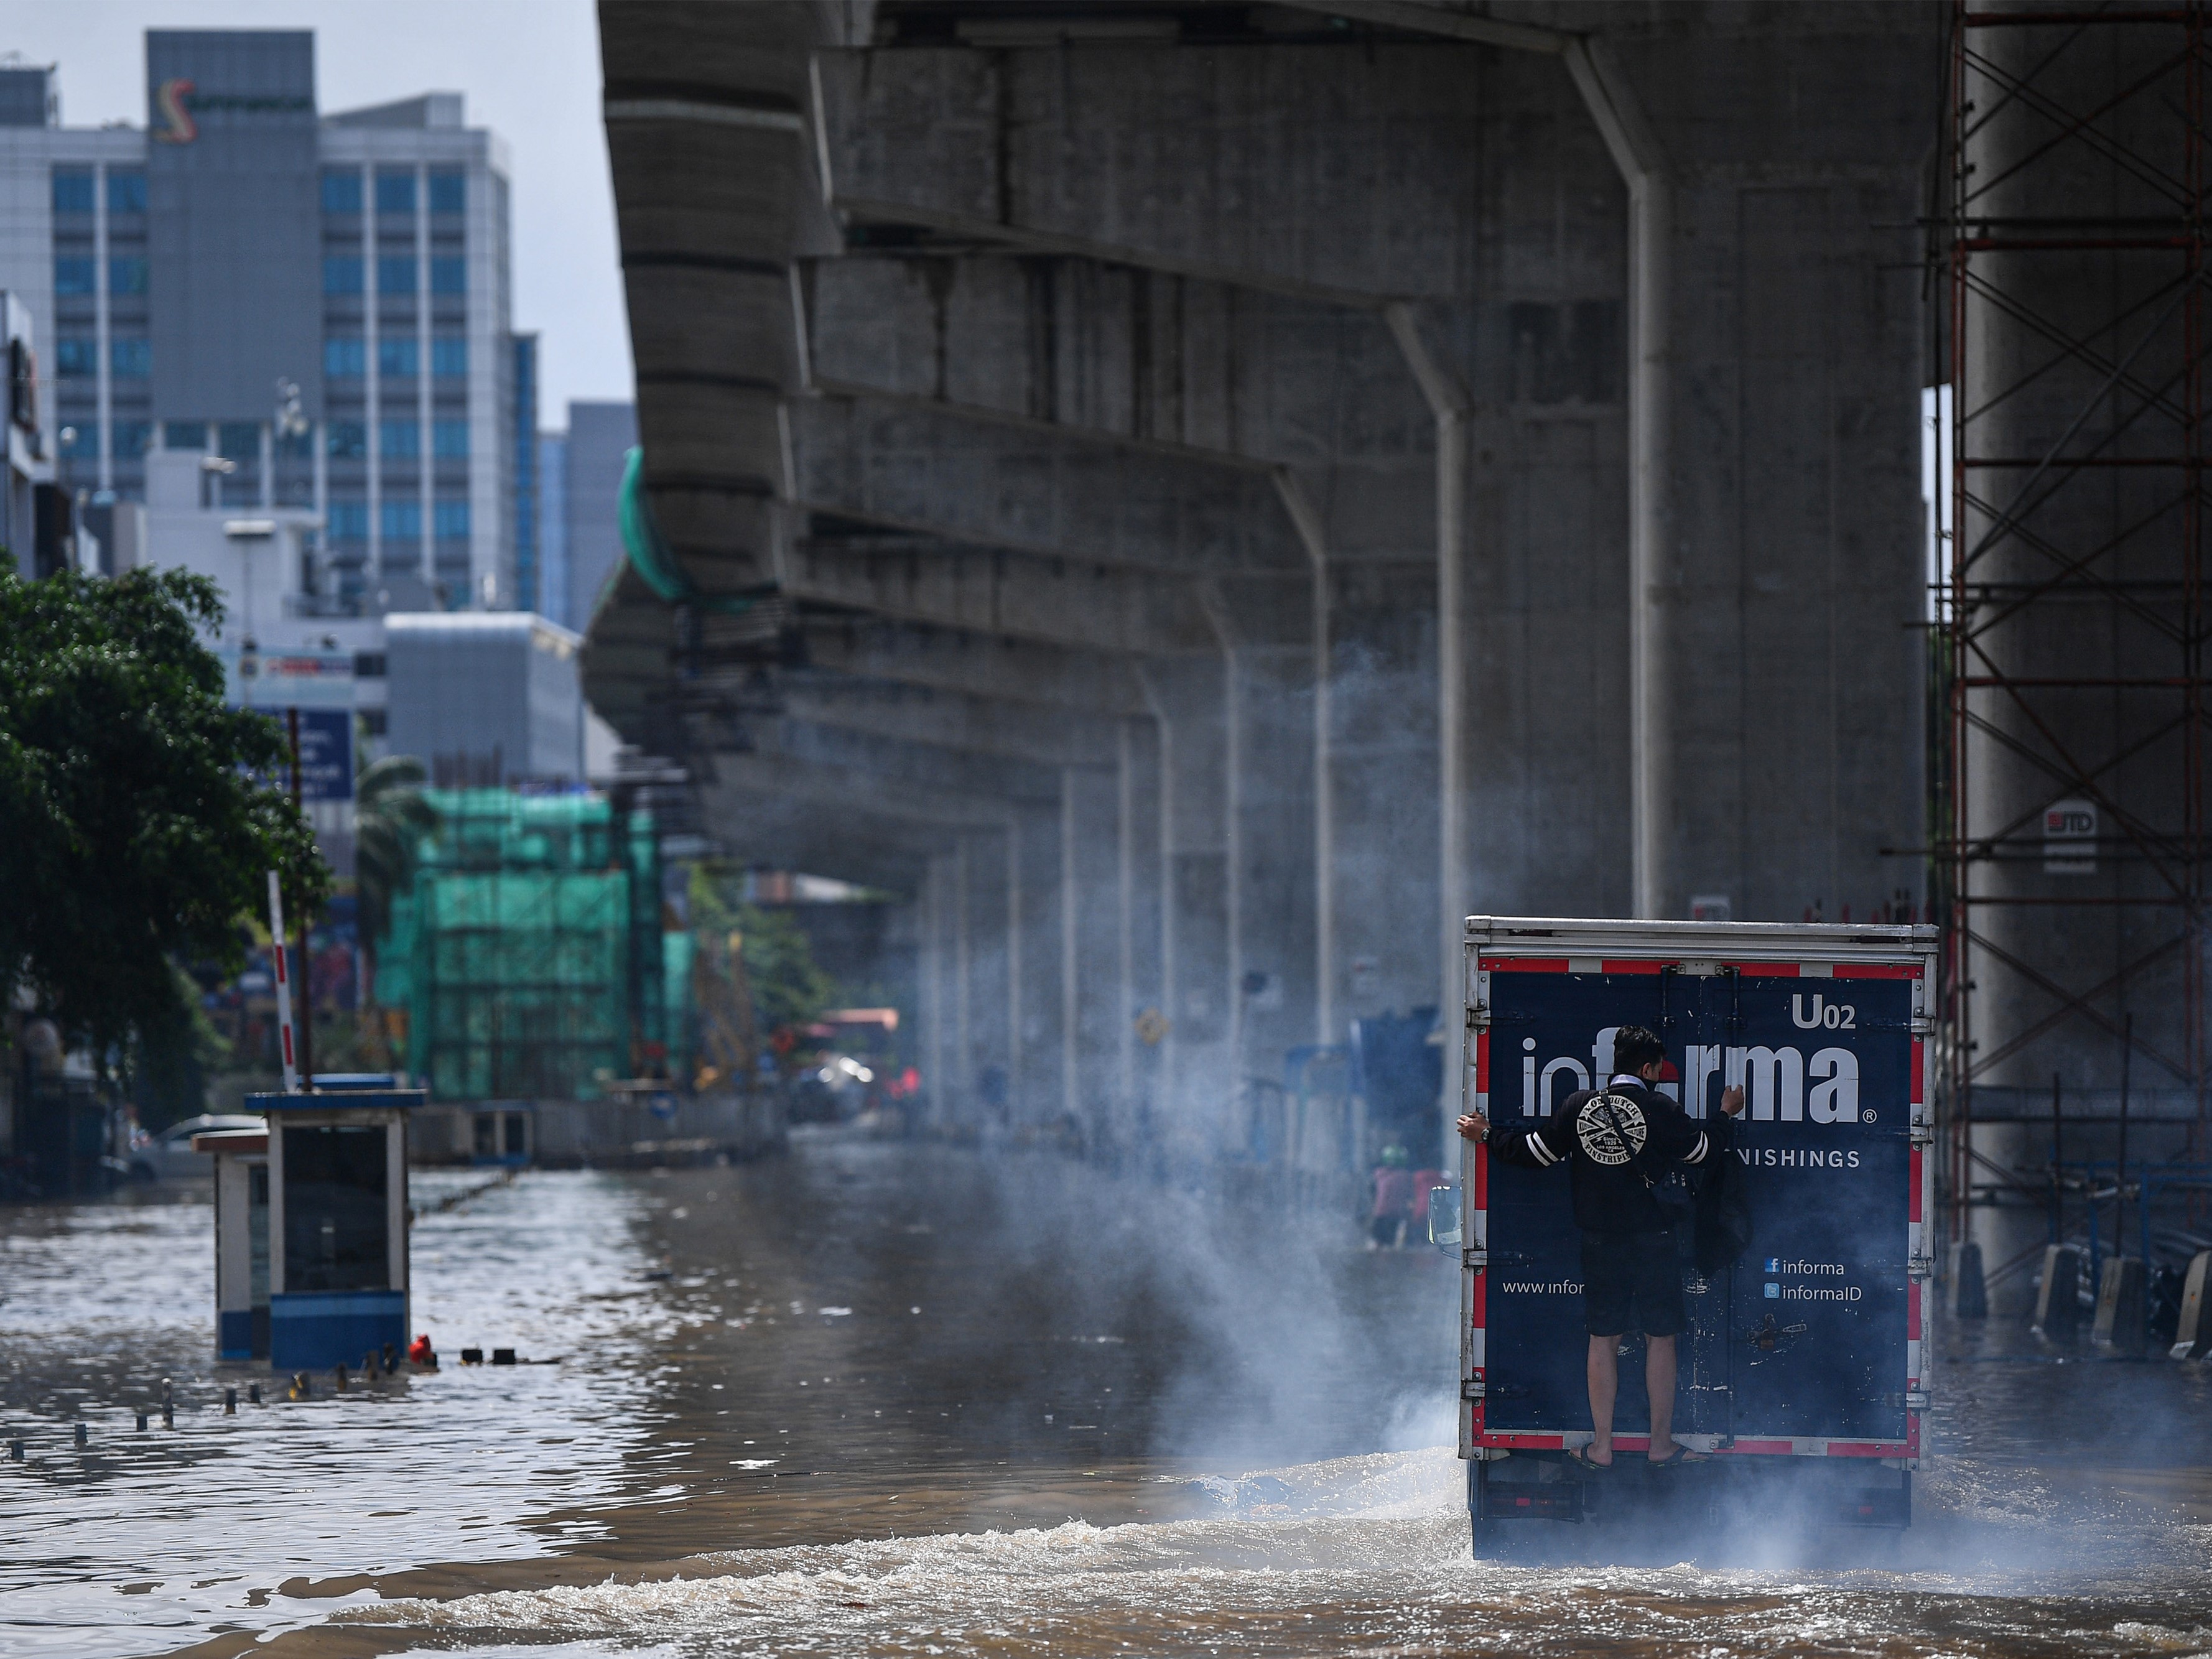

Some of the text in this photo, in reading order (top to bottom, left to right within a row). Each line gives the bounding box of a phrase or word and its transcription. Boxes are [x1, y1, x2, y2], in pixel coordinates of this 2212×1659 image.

[1792, 993, 1856, 1029] U02
[1523, 1027, 1859, 1125] infrma
[1783, 1259, 1844, 1275] informa
